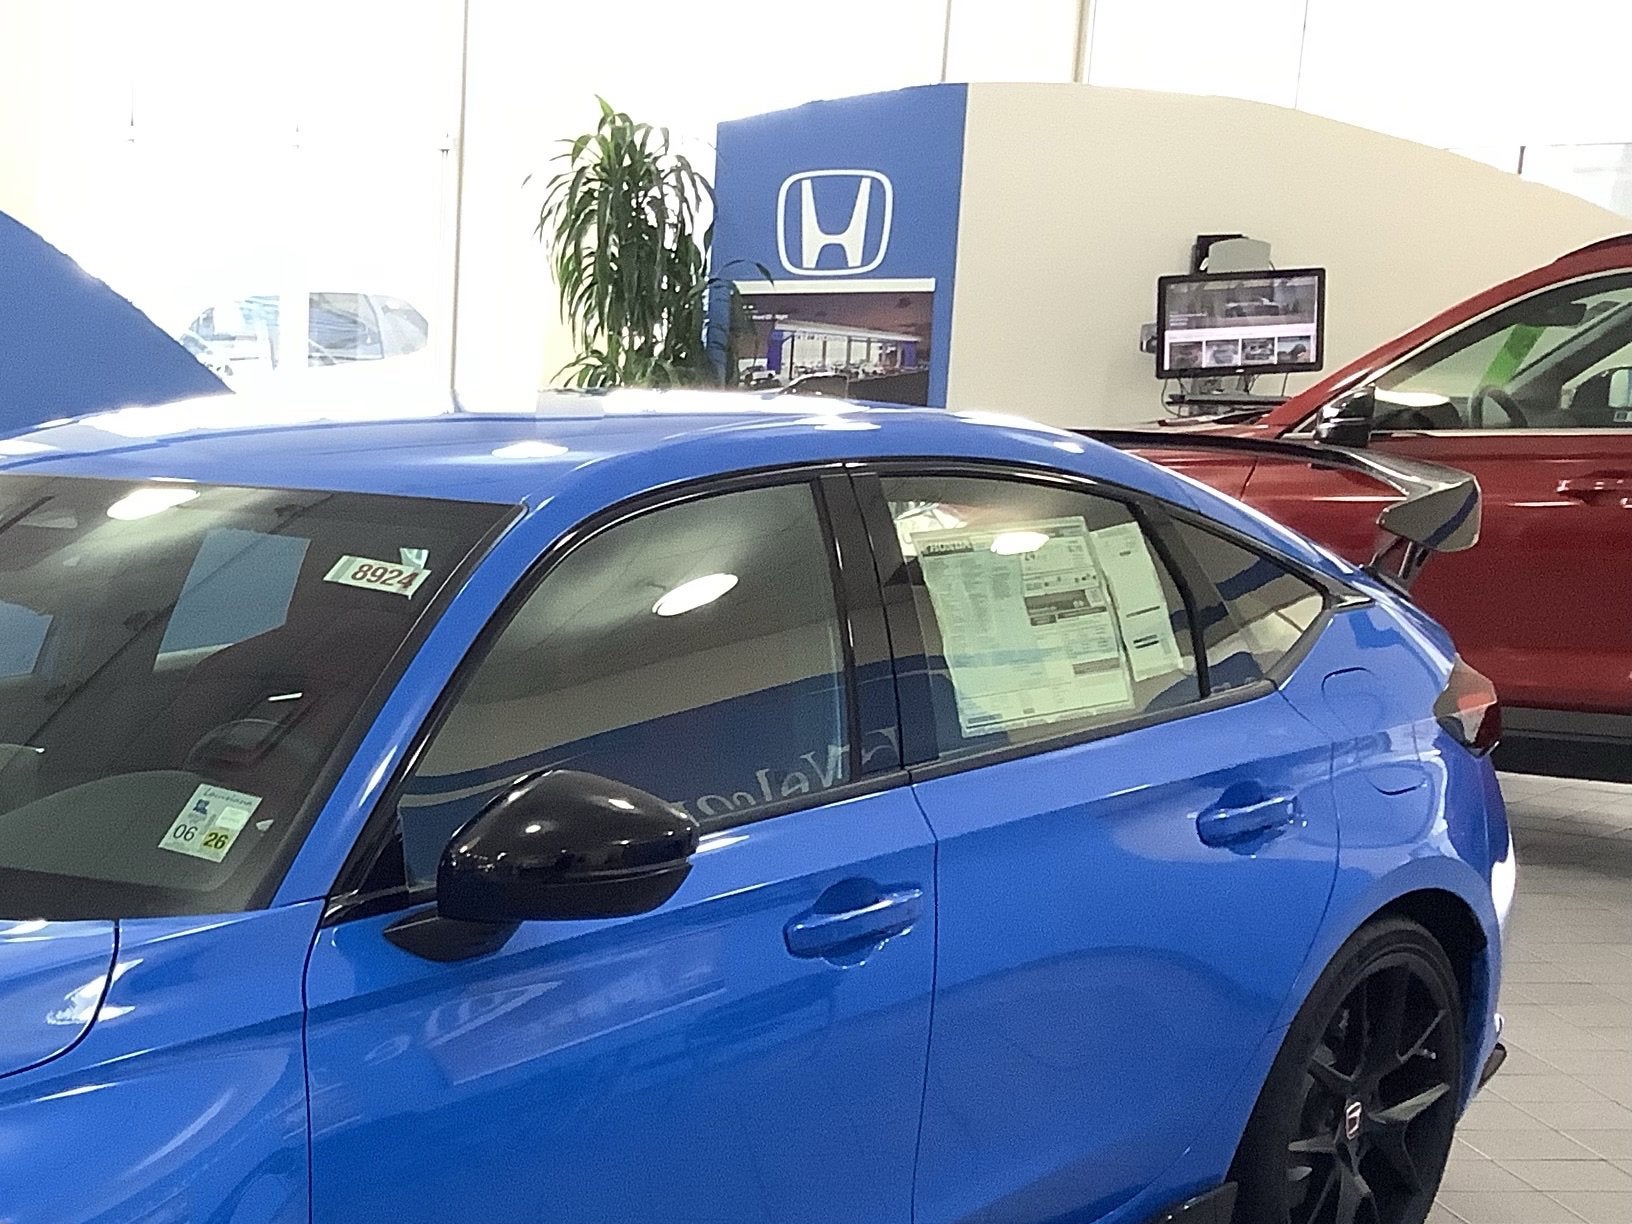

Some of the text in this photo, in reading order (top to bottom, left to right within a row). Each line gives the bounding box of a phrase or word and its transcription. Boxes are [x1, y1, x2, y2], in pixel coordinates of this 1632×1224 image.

[351, 563, 420, 589] 8924
[172, 823, 199, 842] 06
[203, 832, 229, 850] 26
